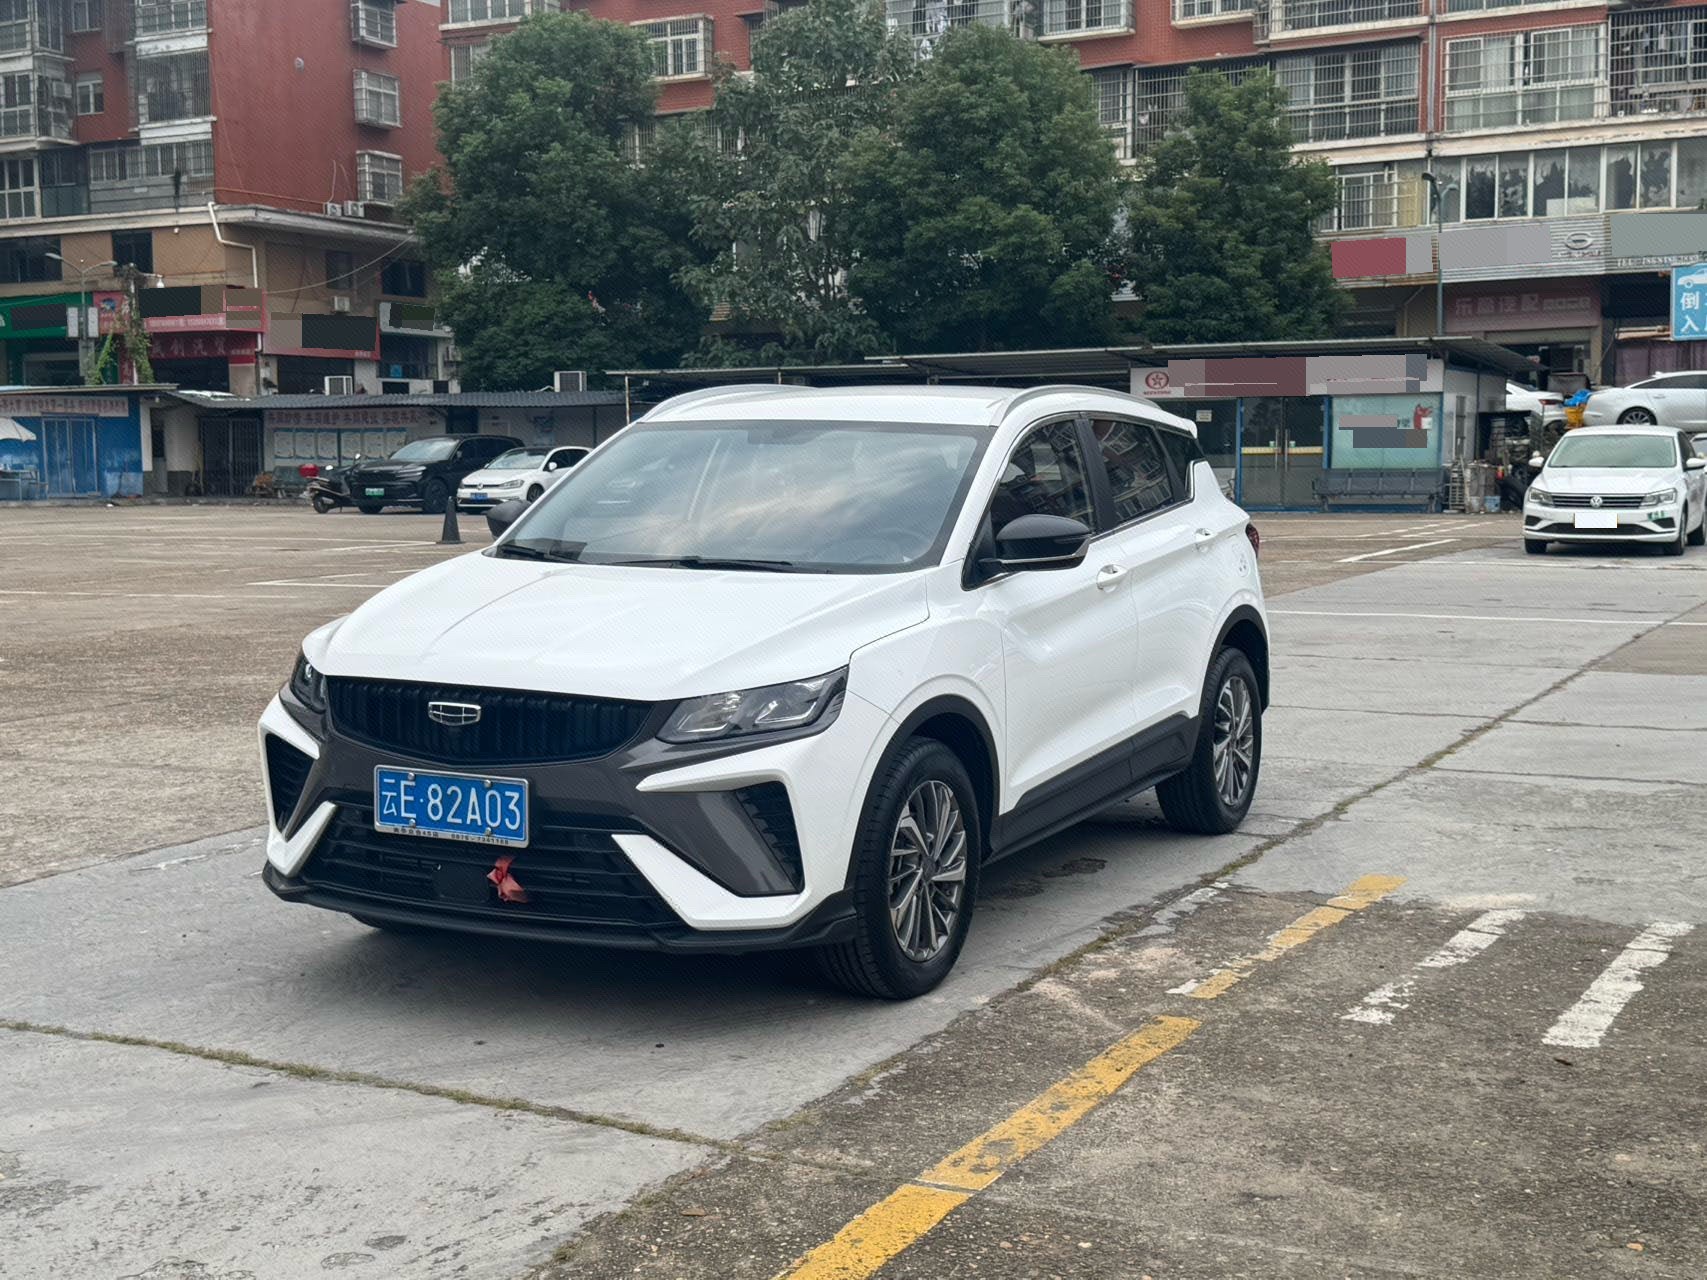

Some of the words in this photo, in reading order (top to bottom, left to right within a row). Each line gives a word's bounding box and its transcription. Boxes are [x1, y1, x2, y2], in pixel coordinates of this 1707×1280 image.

[1680, 291, 1707, 311] 倒
[1681, 314, 1707, 333] 入
[382, 778, 521, 831] 云E·82A03
